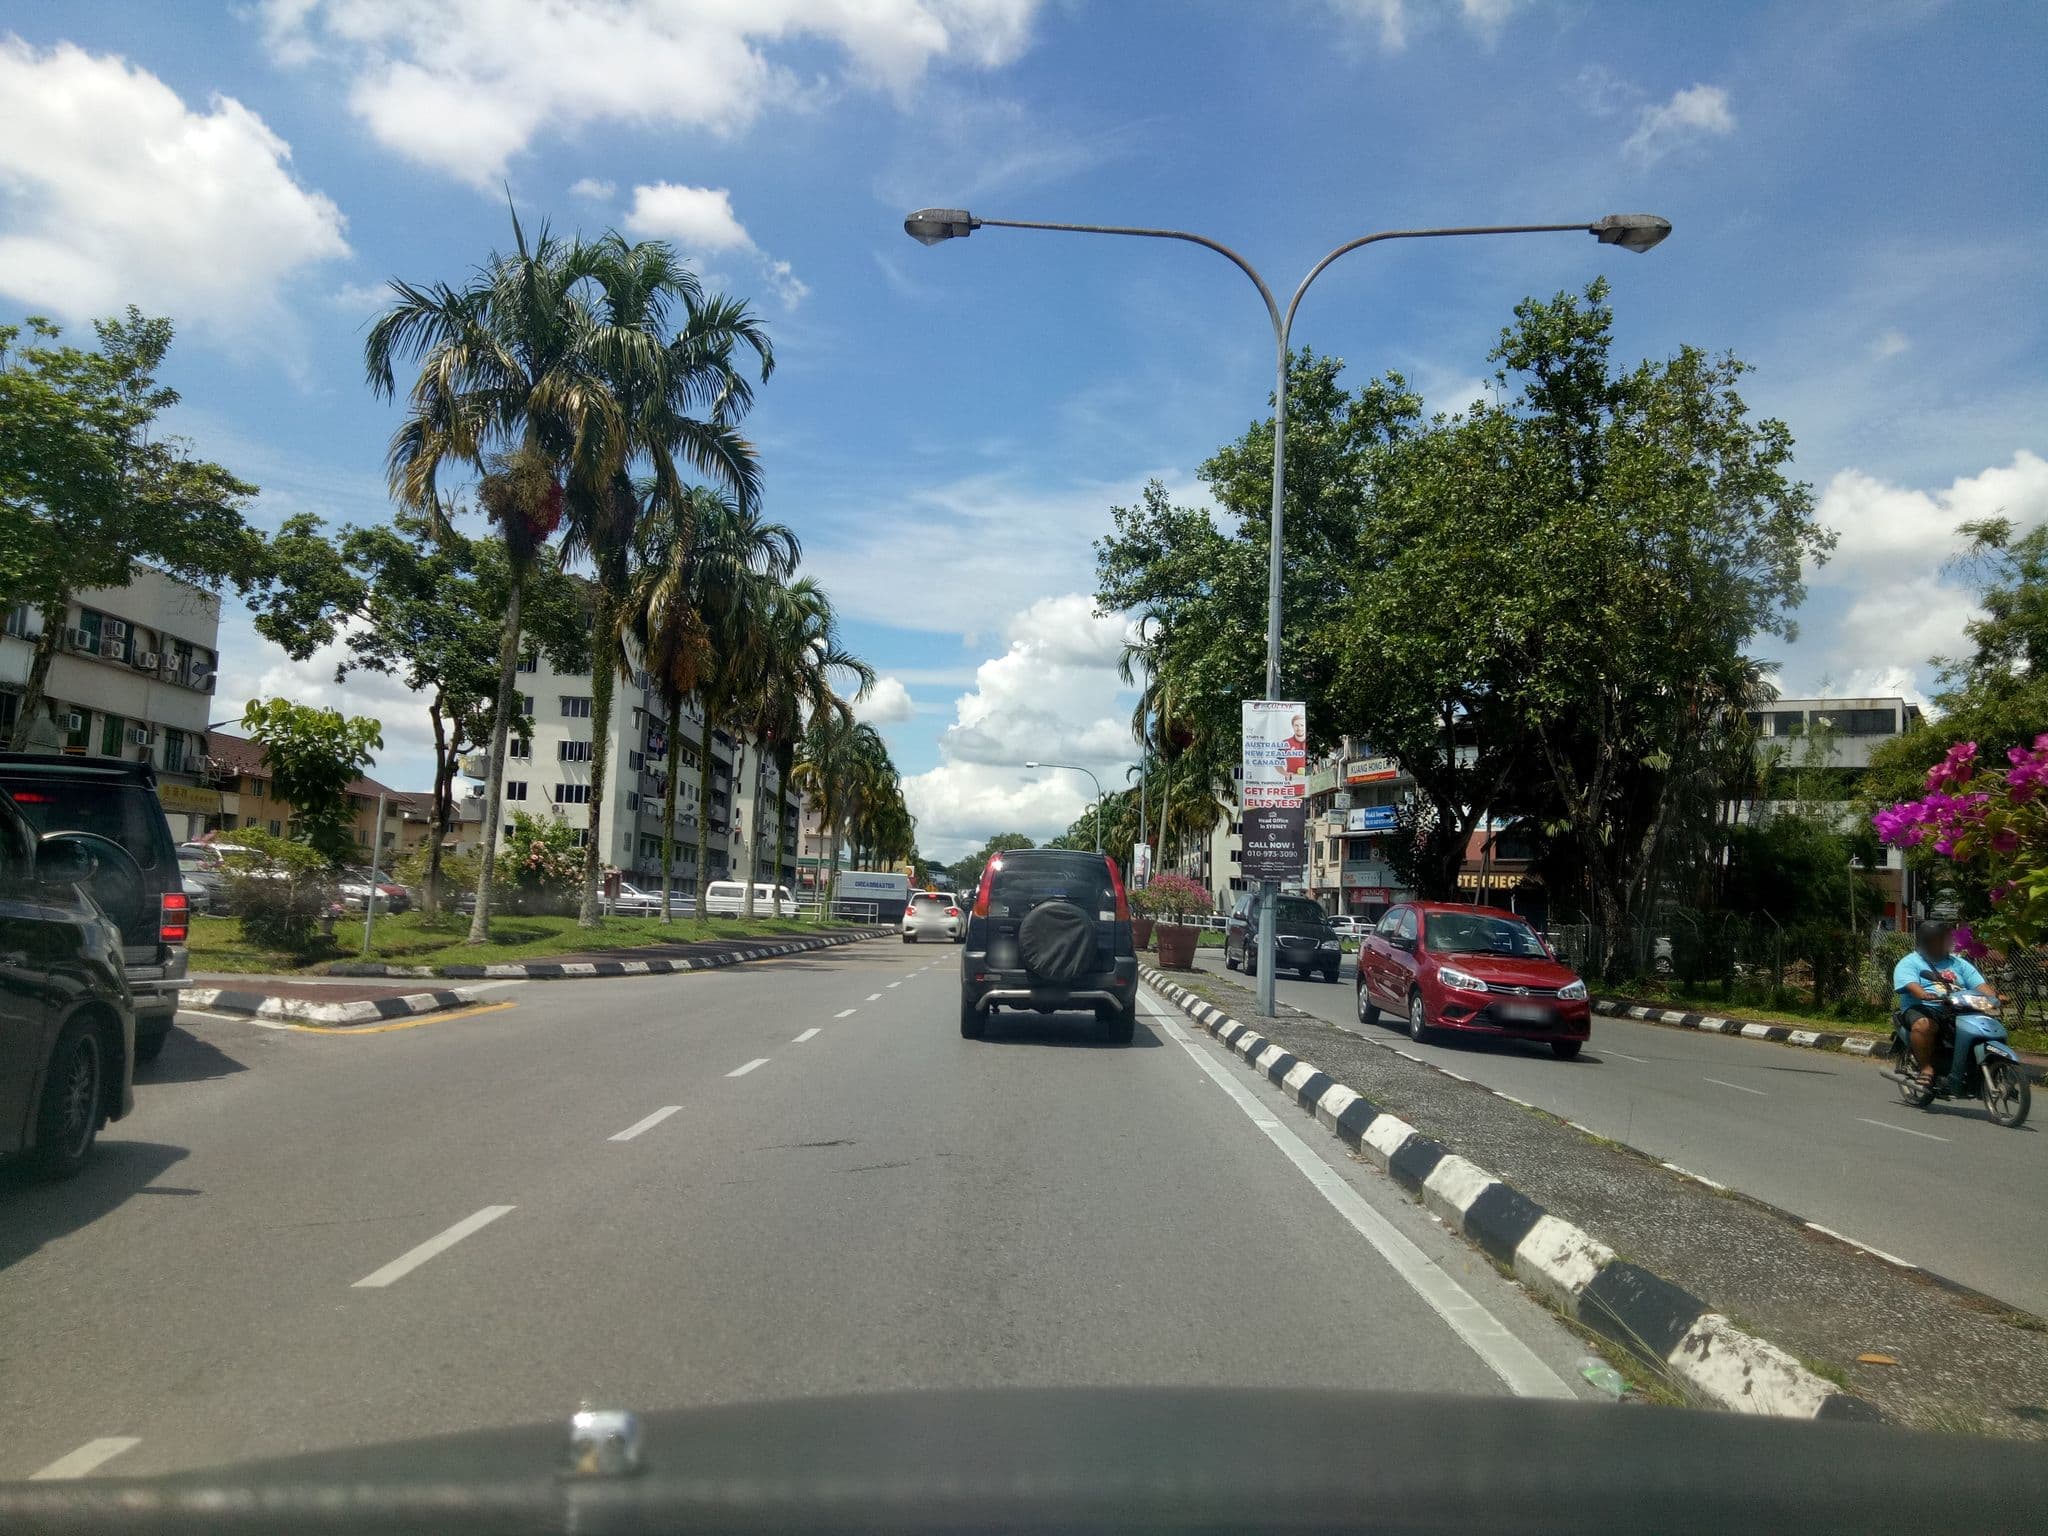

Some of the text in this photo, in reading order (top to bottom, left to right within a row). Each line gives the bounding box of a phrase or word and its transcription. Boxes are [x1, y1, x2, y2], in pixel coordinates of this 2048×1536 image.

[1368, 760, 1383, 770] HONG
[1245, 787, 1294, 796] GET FREE
[1244, 799, 1272, 807] IELTS
